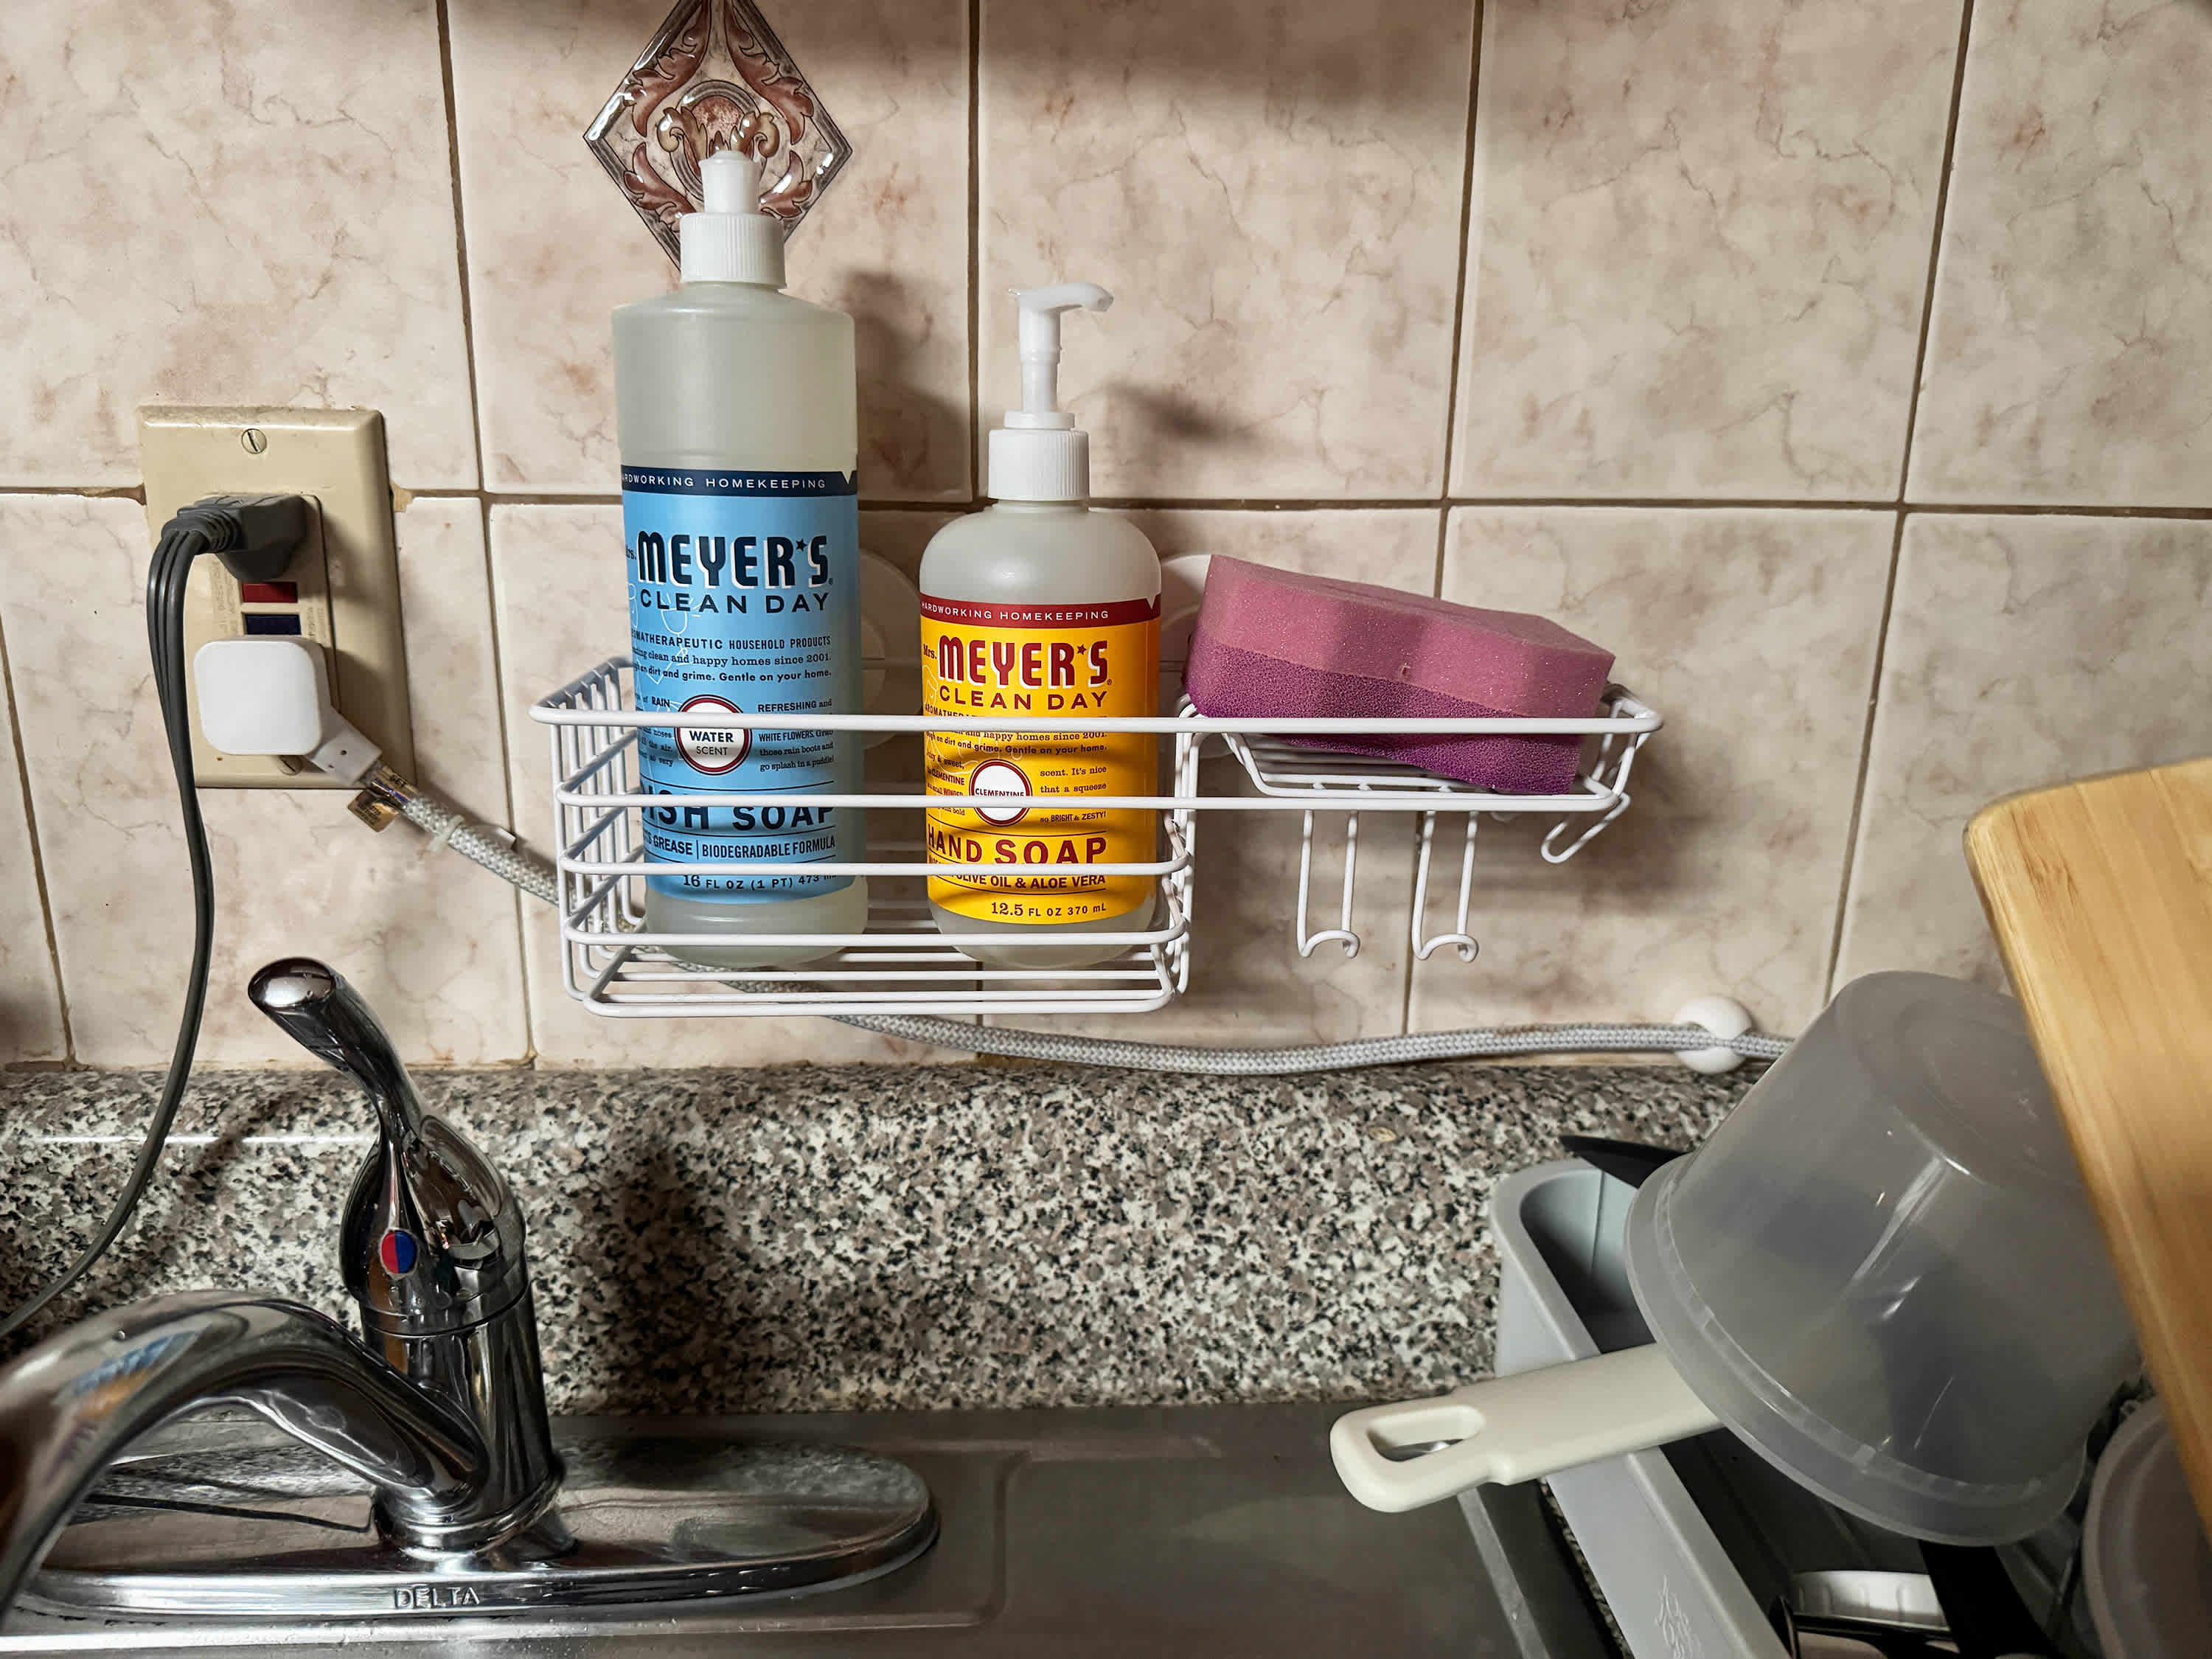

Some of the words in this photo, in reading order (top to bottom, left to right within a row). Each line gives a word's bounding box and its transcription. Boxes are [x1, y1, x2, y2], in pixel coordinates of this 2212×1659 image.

[622, 473, 694, 487] RDWORKING
[706, 478, 826, 489] HOMEKEEPING
[640, 589, 747, 613] CLEAN
[765, 592, 829, 613] DAY
[1000, 611, 1110, 621] HOMEKEEPING
[631, 628, 723, 650] OMATHERAPEUTIC
[729, 639, 785, 650] HOUSEHOLD
[790, 636, 831, 648] PRODUCTS
[648, 650, 669, 661] clean
[672, 655, 689, 664] and
[692, 655, 728, 667] happy
[731, 657, 771, 666] homes
[774, 656, 803, 665] since
[807, 653, 831, 663] 2001.
[923, 643, 937, 660] Mrs.
[649, 665, 661, 675] dirt
[663, 669, 679, 678] and
[682, 672, 715, 681] grime.
[719, 672, 755, 681] Gentle
[759, 673, 773, 681] on
[777, 672, 801, 684] your
[804, 669, 831, 679] home.
[652, 696, 669, 708] RAIN
[758, 700, 816, 712] REFRESHING
[818, 698, 832, 708] and
[939, 685, 1031, 710] CLEAN
[1048, 691, 1107, 710] DAY
[689, 730, 734, 742] WATER
[759, 732, 781, 742] WHITE
[983, 731, 1013, 742] happy
[1016, 731, 1050, 741] homes
[1053, 732, 1080, 741] since
[696, 745, 728, 756] SCENT
[759, 748, 783, 757] those
[784, 746, 800, 755] rain
[801, 745, 821, 754] boots
[822, 742, 833, 751] and
[945, 737, 956, 745] dirt
[958, 741, 972, 749] and
[974, 744, 1002, 753] grime.
[1005, 745, 1037, 754] Gentle
[1055, 746, 1077, 756] your
[1080, 745, 1107, 753] home.
[760, 764, 770, 772] go
[771, 760, 796, 771] splash
[1071, 768, 1086, 776] It's
[1089, 766, 1107, 774] nice
[932, 768, 964, 785] CLEMENTINE
[1040, 785, 1060, 793] that
[1074, 783, 1107, 793] squeeze
[641, 785, 709, 830] ISH
[1051, 813, 1073, 823] BRIGHT
[1082, 811, 1106, 821] ZESTY!
[653, 835, 693, 855] GREASE
[702, 843, 790, 858] BIODEGRADABLE
[793, 835, 835, 855] FORMULA
[928, 824, 982, 863] HAND
[994, 837, 1107, 864] SOAP
[684, 875, 700, 887] 16
[706, 880, 720, 889] FL
[726, 880, 744, 890] OZ
[751, 880, 765, 891] (1
[772, 877, 793, 889] PT)
[799, 874, 819, 885] 473
[990, 875, 1011, 888] OIL
[1015, 877, 1026, 888] &
[1030, 877, 1067, 889] ALOE
[1071, 874, 1106, 886] VERA
[992, 902, 1023, 917] 12.5
[1029, 908, 1041, 917] FL
[1046, 908, 1062, 917] OZ
[1068, 905, 1088, 915] 370
[1093, 902, 1106, 913] mL
[395, 1586, 480, 1610] DELTA
